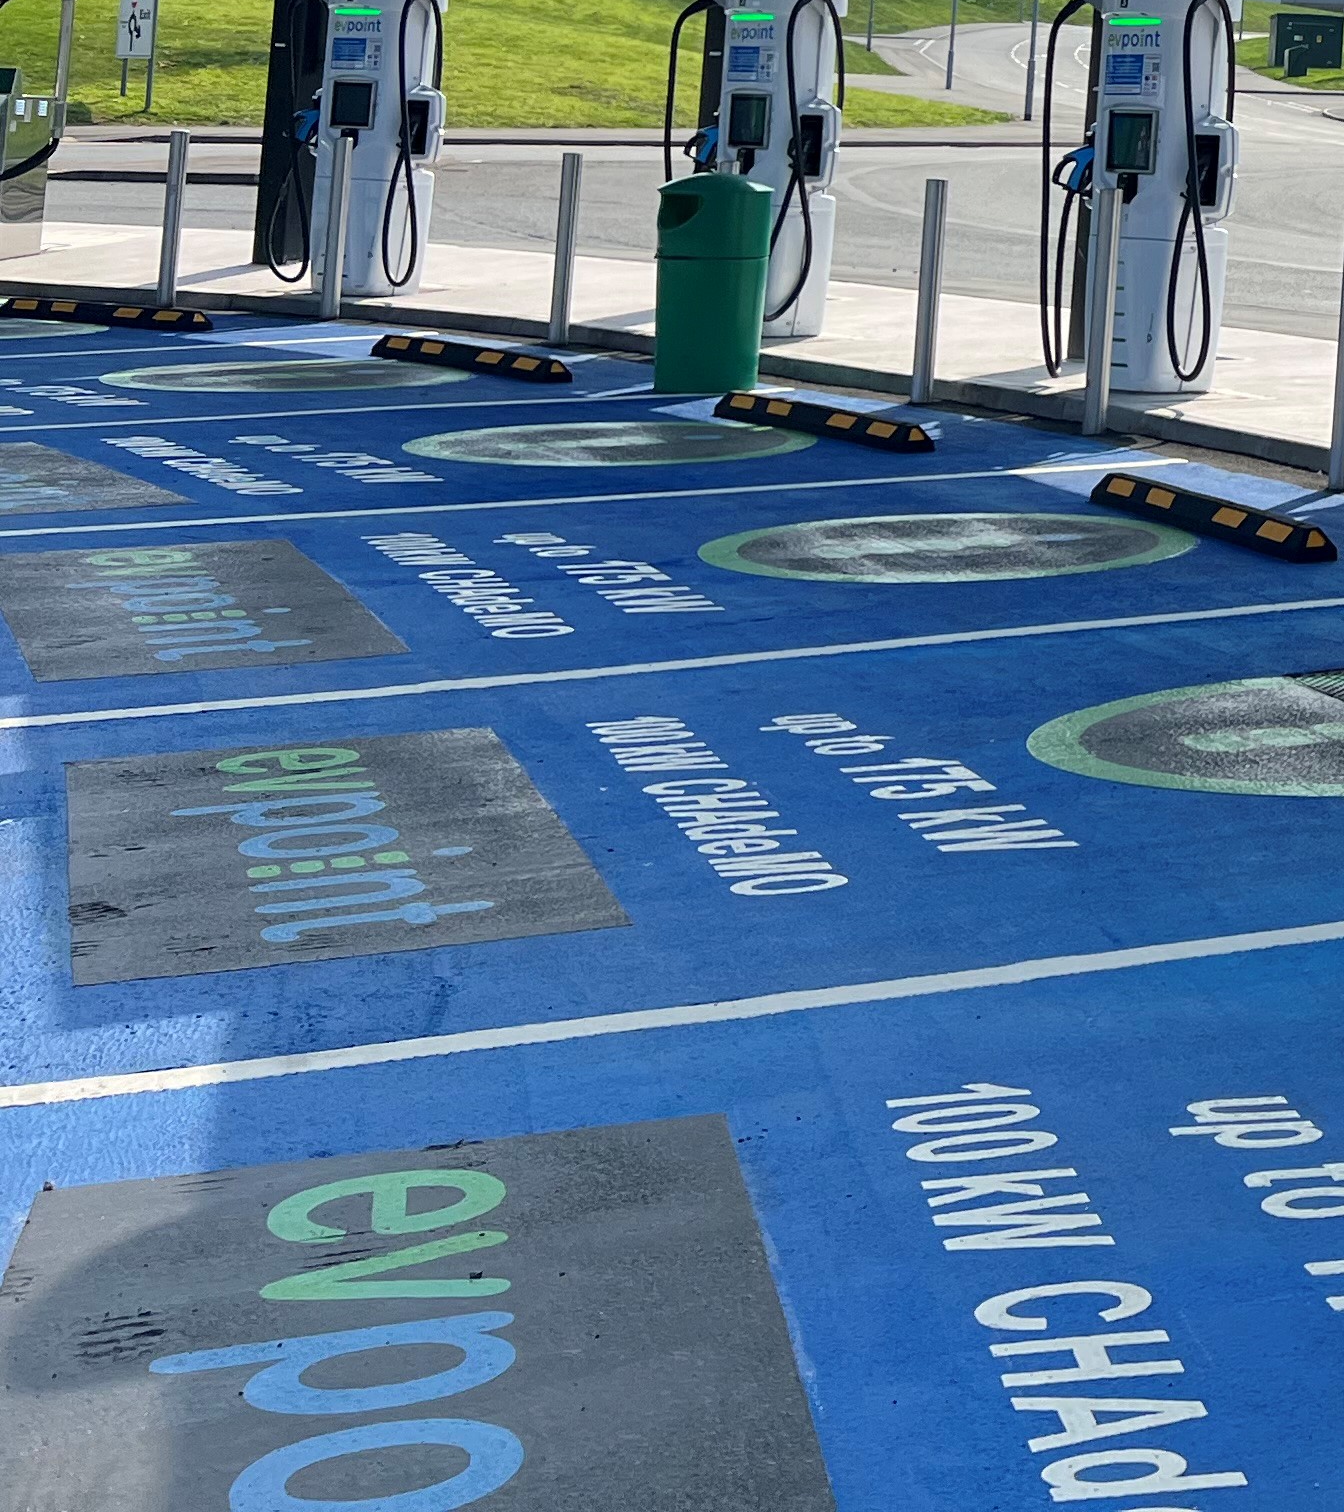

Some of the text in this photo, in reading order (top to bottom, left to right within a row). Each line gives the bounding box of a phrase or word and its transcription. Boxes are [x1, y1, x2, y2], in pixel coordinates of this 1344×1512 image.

[333, 16, 382, 34] evpoint
[730, 23, 774, 43] evpoint
[1107, 28, 1161, 50] evpoint
[556, 559, 673, 586] 175
[65, 549, 315, 662] evpoint
[759, 712, 858, 735] up
[804, 734, 897, 756] to
[839, 756, 998, 801] 175
[169, 746, 496, 944] evpoint
[641, 777, 849, 897] CHAdeMO
[1169, 1094, 1325, 1150] up
[973, 1280, 1249, 1512] CHAd
